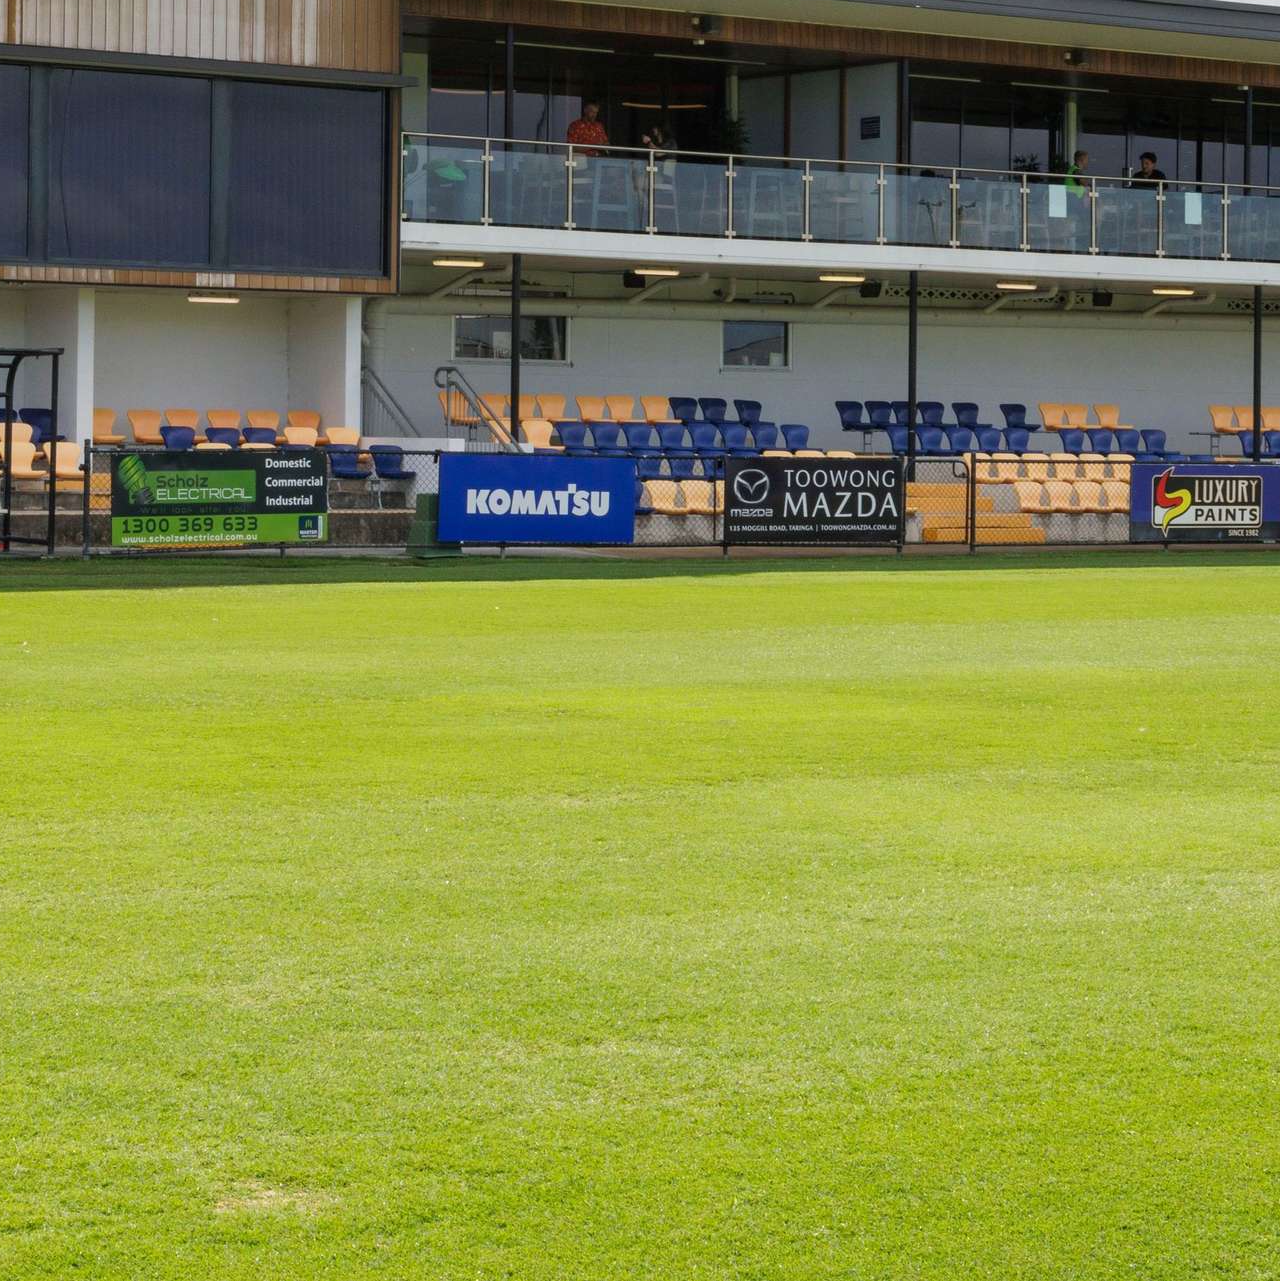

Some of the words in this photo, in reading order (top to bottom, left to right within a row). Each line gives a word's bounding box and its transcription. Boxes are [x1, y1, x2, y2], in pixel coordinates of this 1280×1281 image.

[265, 458, 312, 469] Domestic
[156, 474, 209, 488] Scholz
[265, 476, 323, 487] Commercial
[783, 469, 896, 488] TOOWONG
[156, 488, 253, 500] ELECTRICAL
[1194, 479, 1259, 503] LUXURY
[265, 495, 313, 506] Industrial
[466, 483, 610, 517] KOMATSU
[783, 491, 898, 518] MAZDA
[1194, 508, 1258, 522] PAINTS
[122, 518, 169, 534] 1300
[178, 517, 214, 532] 369
[223, 516, 258, 532] 633
[121, 533, 258, 544] www.scholzelectrical.com.au
[1228, 529, 1245, 537] SINCE
